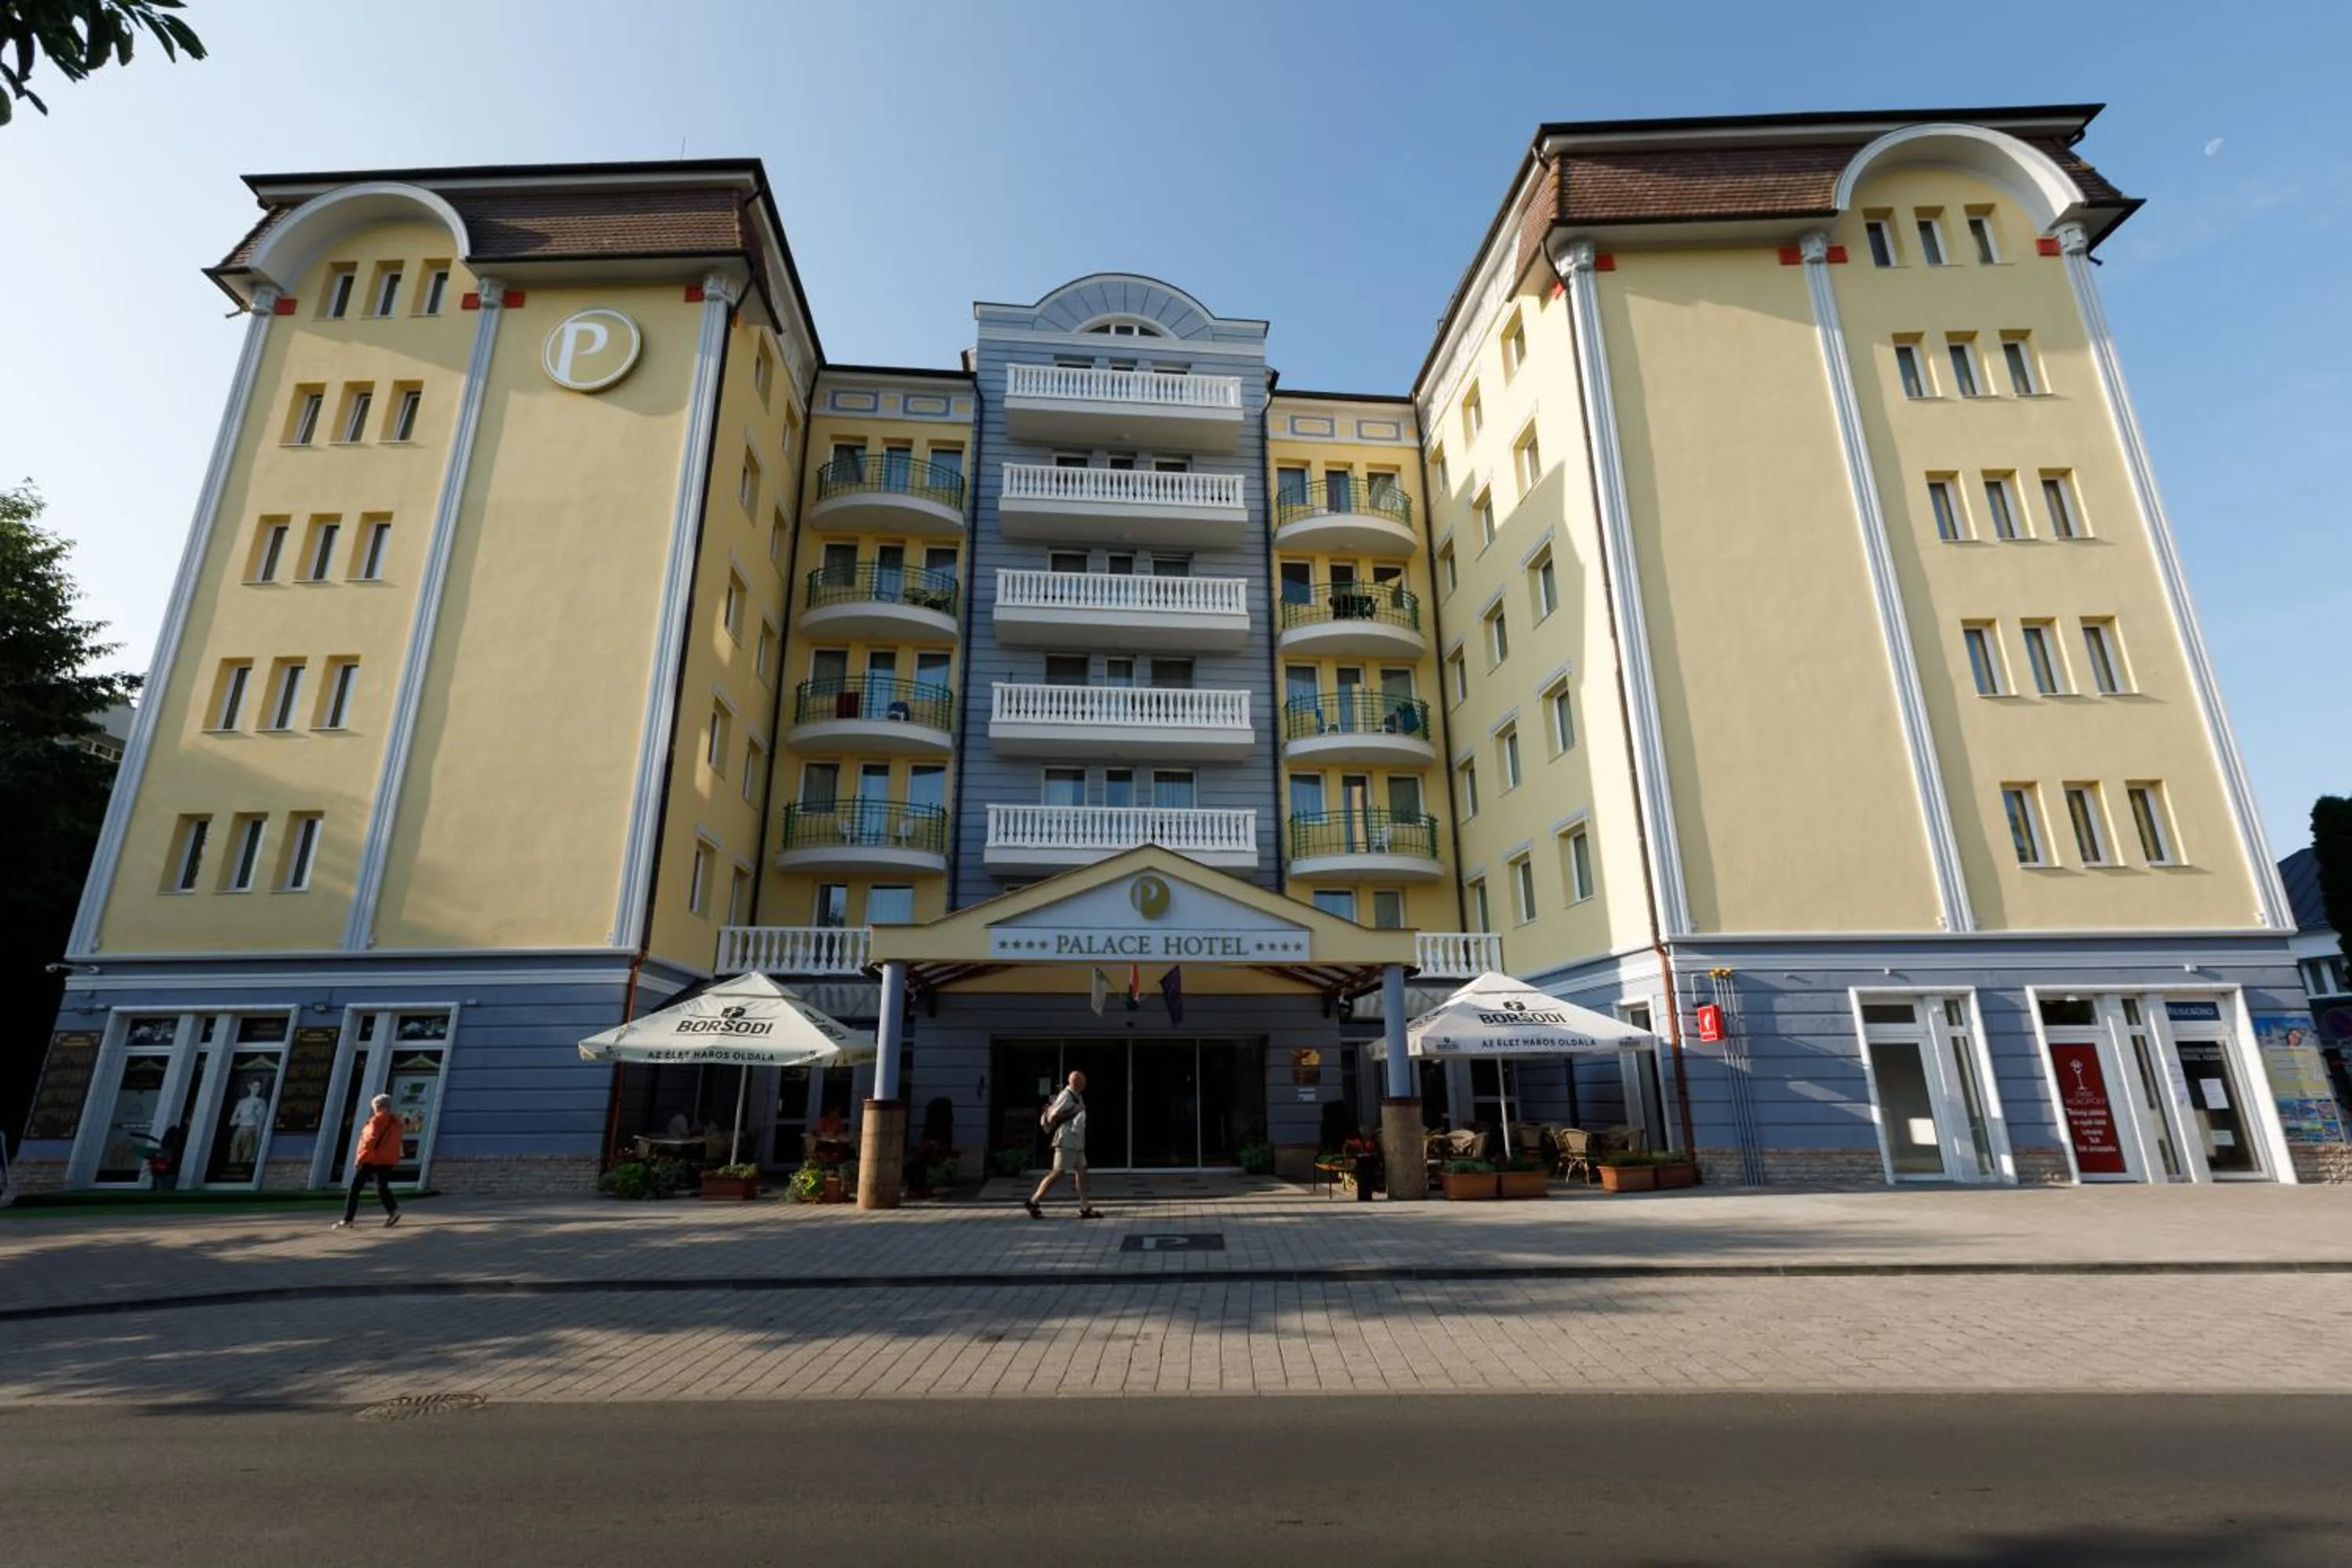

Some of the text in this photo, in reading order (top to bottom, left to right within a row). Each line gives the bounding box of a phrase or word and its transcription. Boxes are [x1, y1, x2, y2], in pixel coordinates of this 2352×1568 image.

[557, 322, 608, 382] P
[1054, 935, 1250, 956] PALACE HOTEL
[1478, 1012, 1568, 1025] BORSODI
[675, 1019, 775, 1035] BORSODI
[1481, 1040, 1494, 1048] AZ
[647, 1051, 662, 1059] AZ
[732, 1051, 775, 1061] OLDALA
